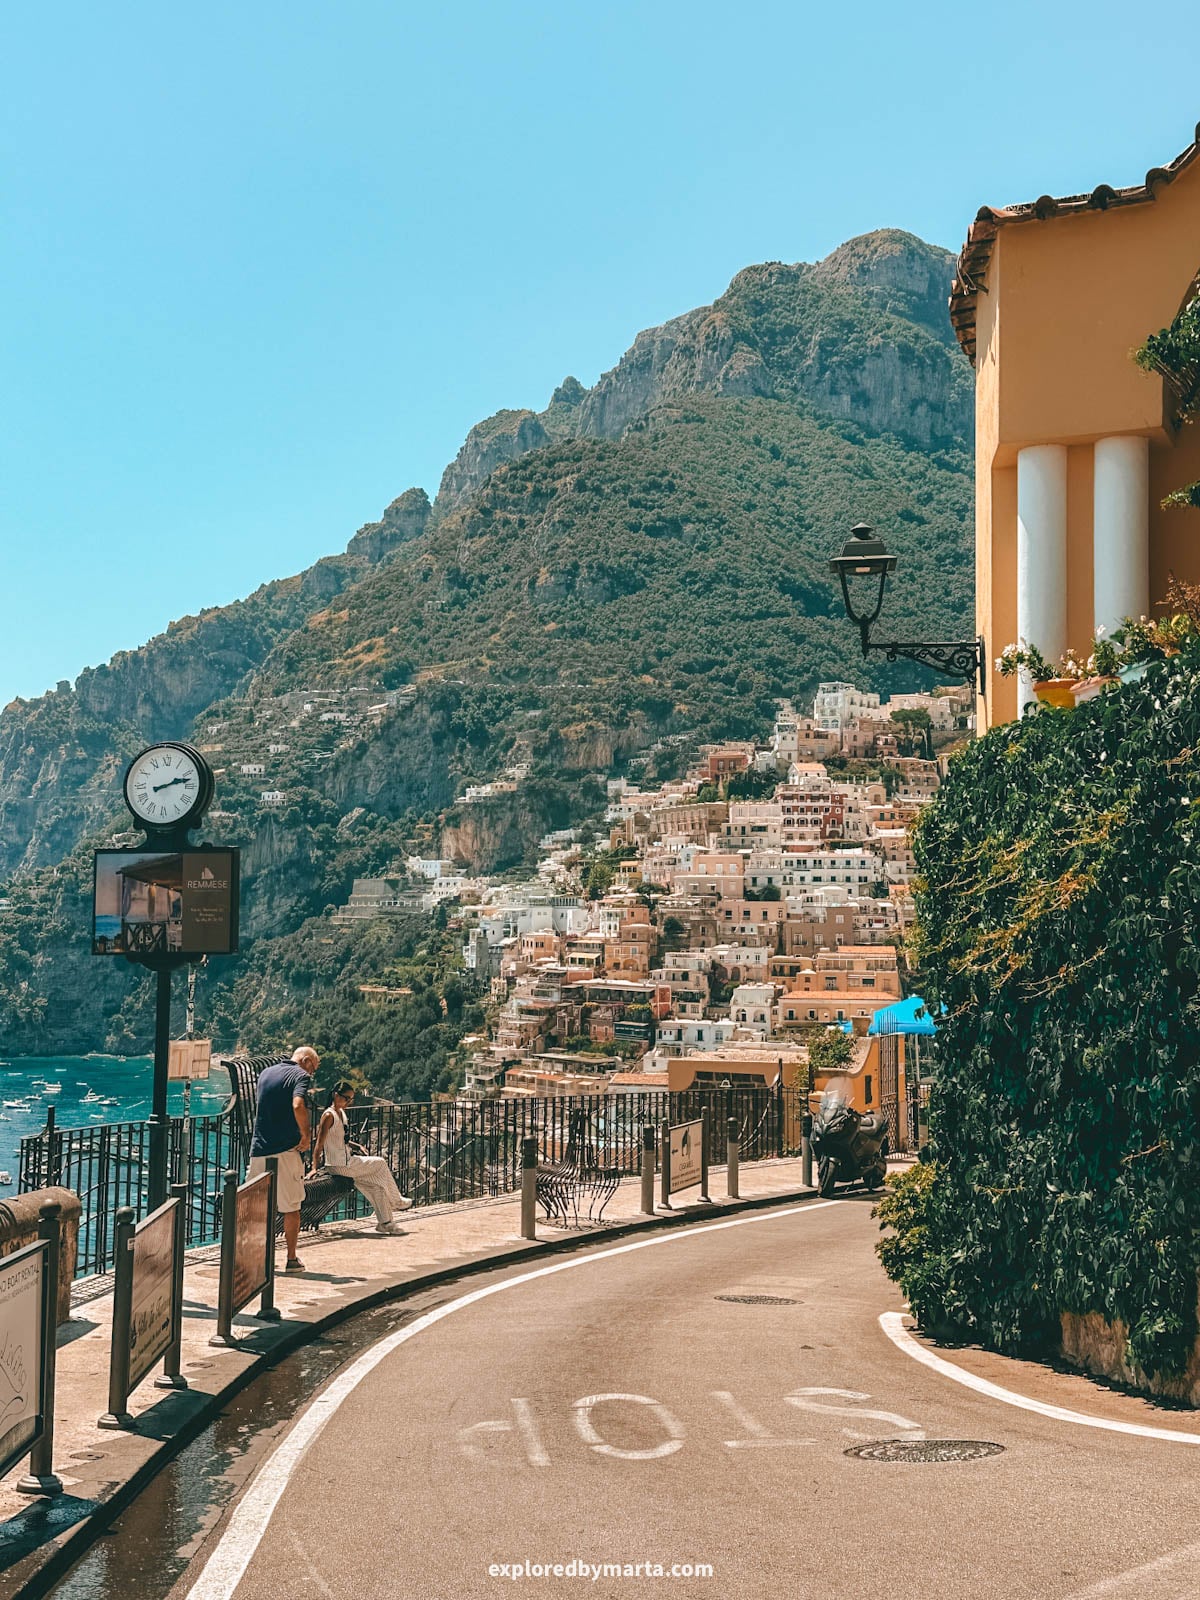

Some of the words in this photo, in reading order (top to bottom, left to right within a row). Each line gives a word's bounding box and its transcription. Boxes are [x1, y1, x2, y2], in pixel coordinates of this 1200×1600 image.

[187, 880, 228, 889] REMMESE
[7, 1271, 21, 1290] BOAT
[456, 1387, 925, 1467] STOP
